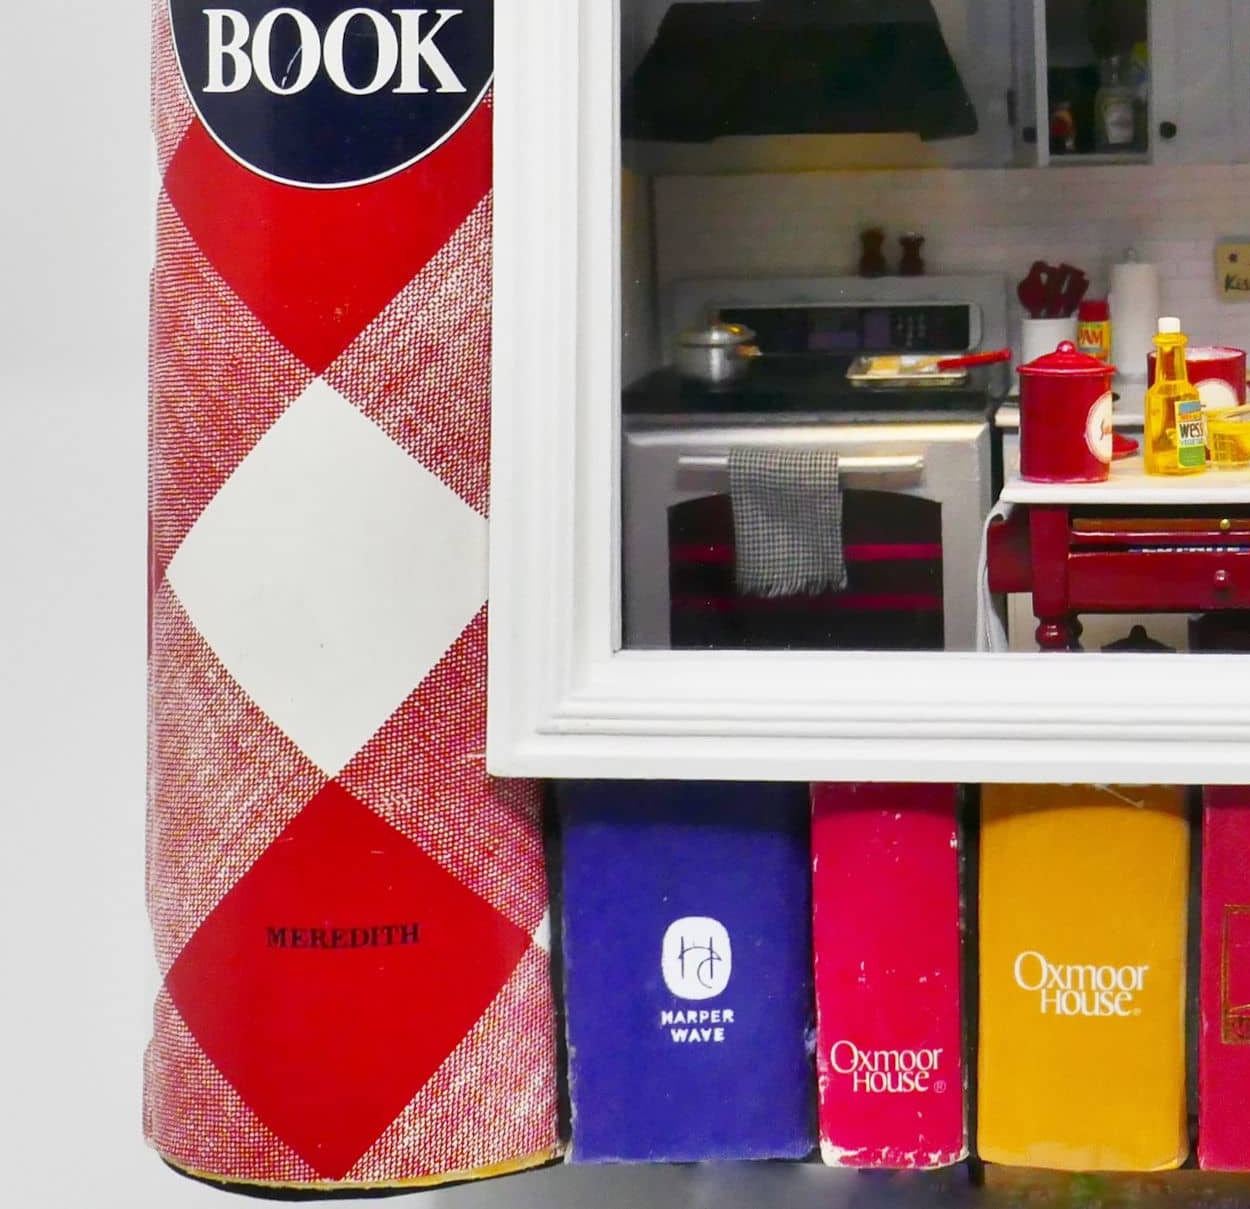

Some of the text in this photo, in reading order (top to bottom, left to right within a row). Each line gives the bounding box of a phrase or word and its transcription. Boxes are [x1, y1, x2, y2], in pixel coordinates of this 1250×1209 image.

[202, 7, 467, 95] BOOK
[266, 923, 420, 949] MEREDITH
[1014, 951, 1150, 991] Oxmoor
[661, 1008, 735, 1026] HARPER
[670, 1027, 726, 1043] WAVE
[830, 1039, 944, 1074] Oxmoor
